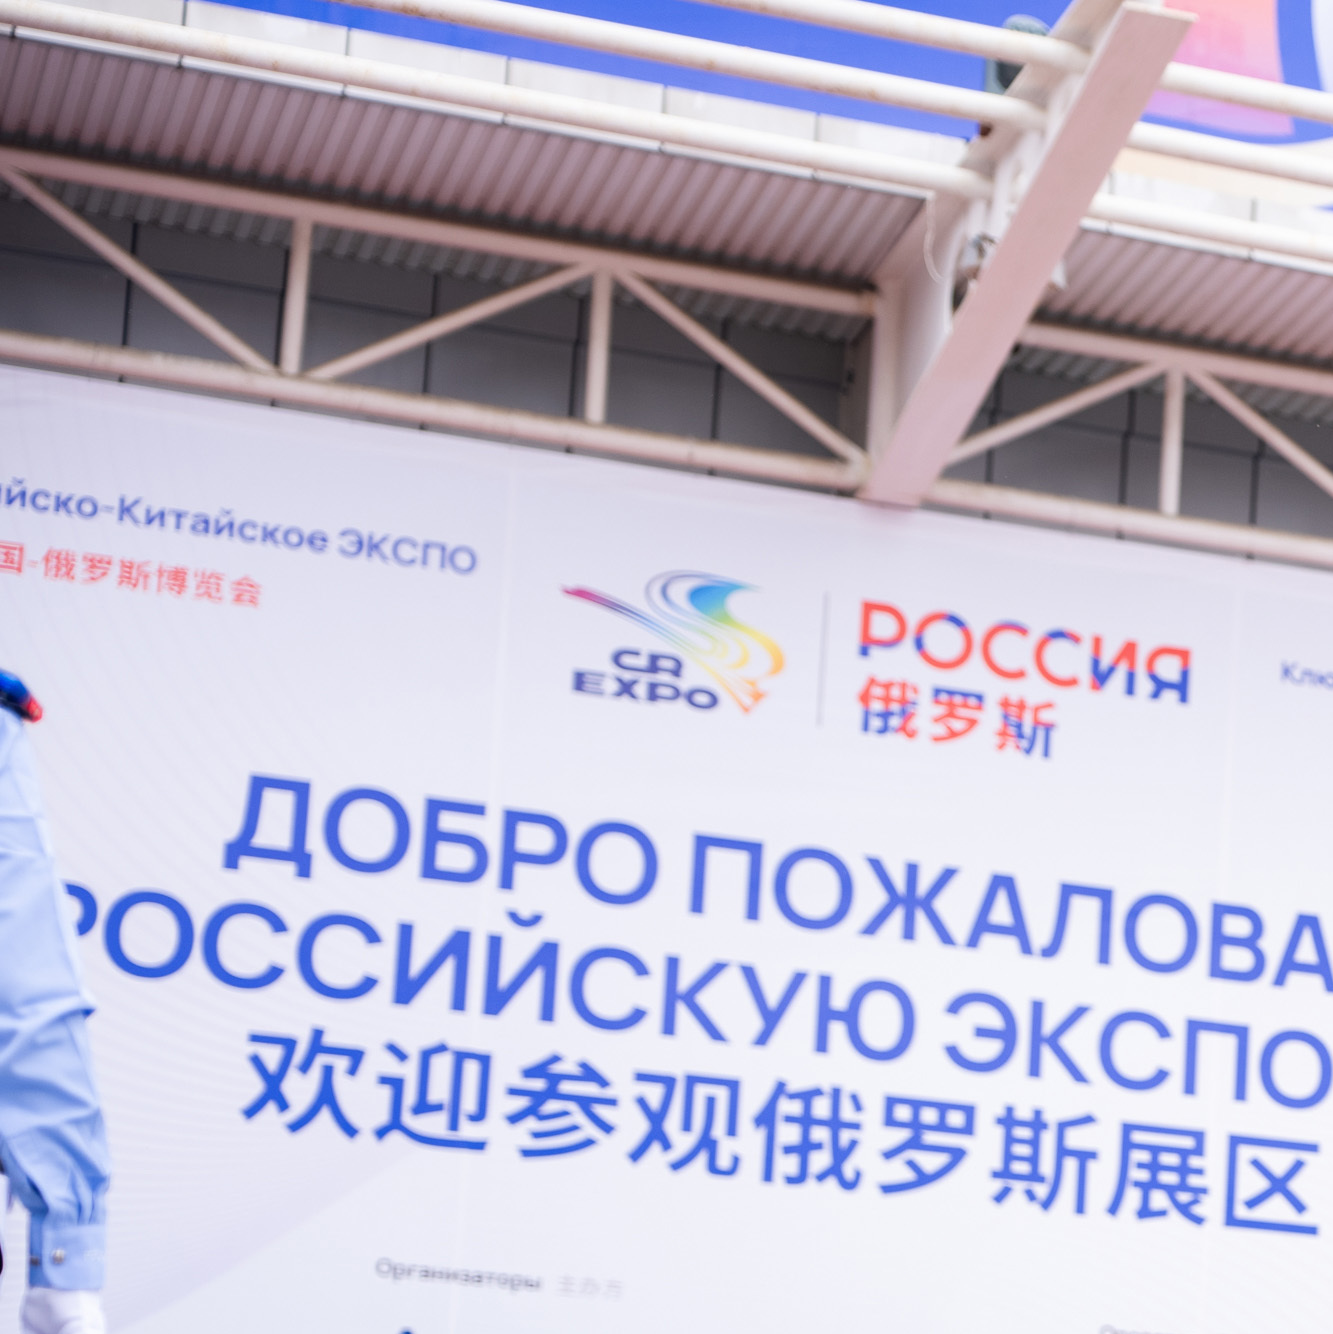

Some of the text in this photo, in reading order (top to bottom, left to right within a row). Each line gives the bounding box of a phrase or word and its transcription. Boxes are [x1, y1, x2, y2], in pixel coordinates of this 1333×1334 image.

[0, 478, 479, 576] йско-Китайское ЭКСПО
[571, 668, 720, 711] EXPO
[611, 646, 685, 680] CR
[857, 598, 1193, 706] РОССИЯ
[858, 676, 1058, 760] 俄罗斯
[221, 769, 662, 910] ДОБРО
[375, 1257, 542, 1291] Организаторы
